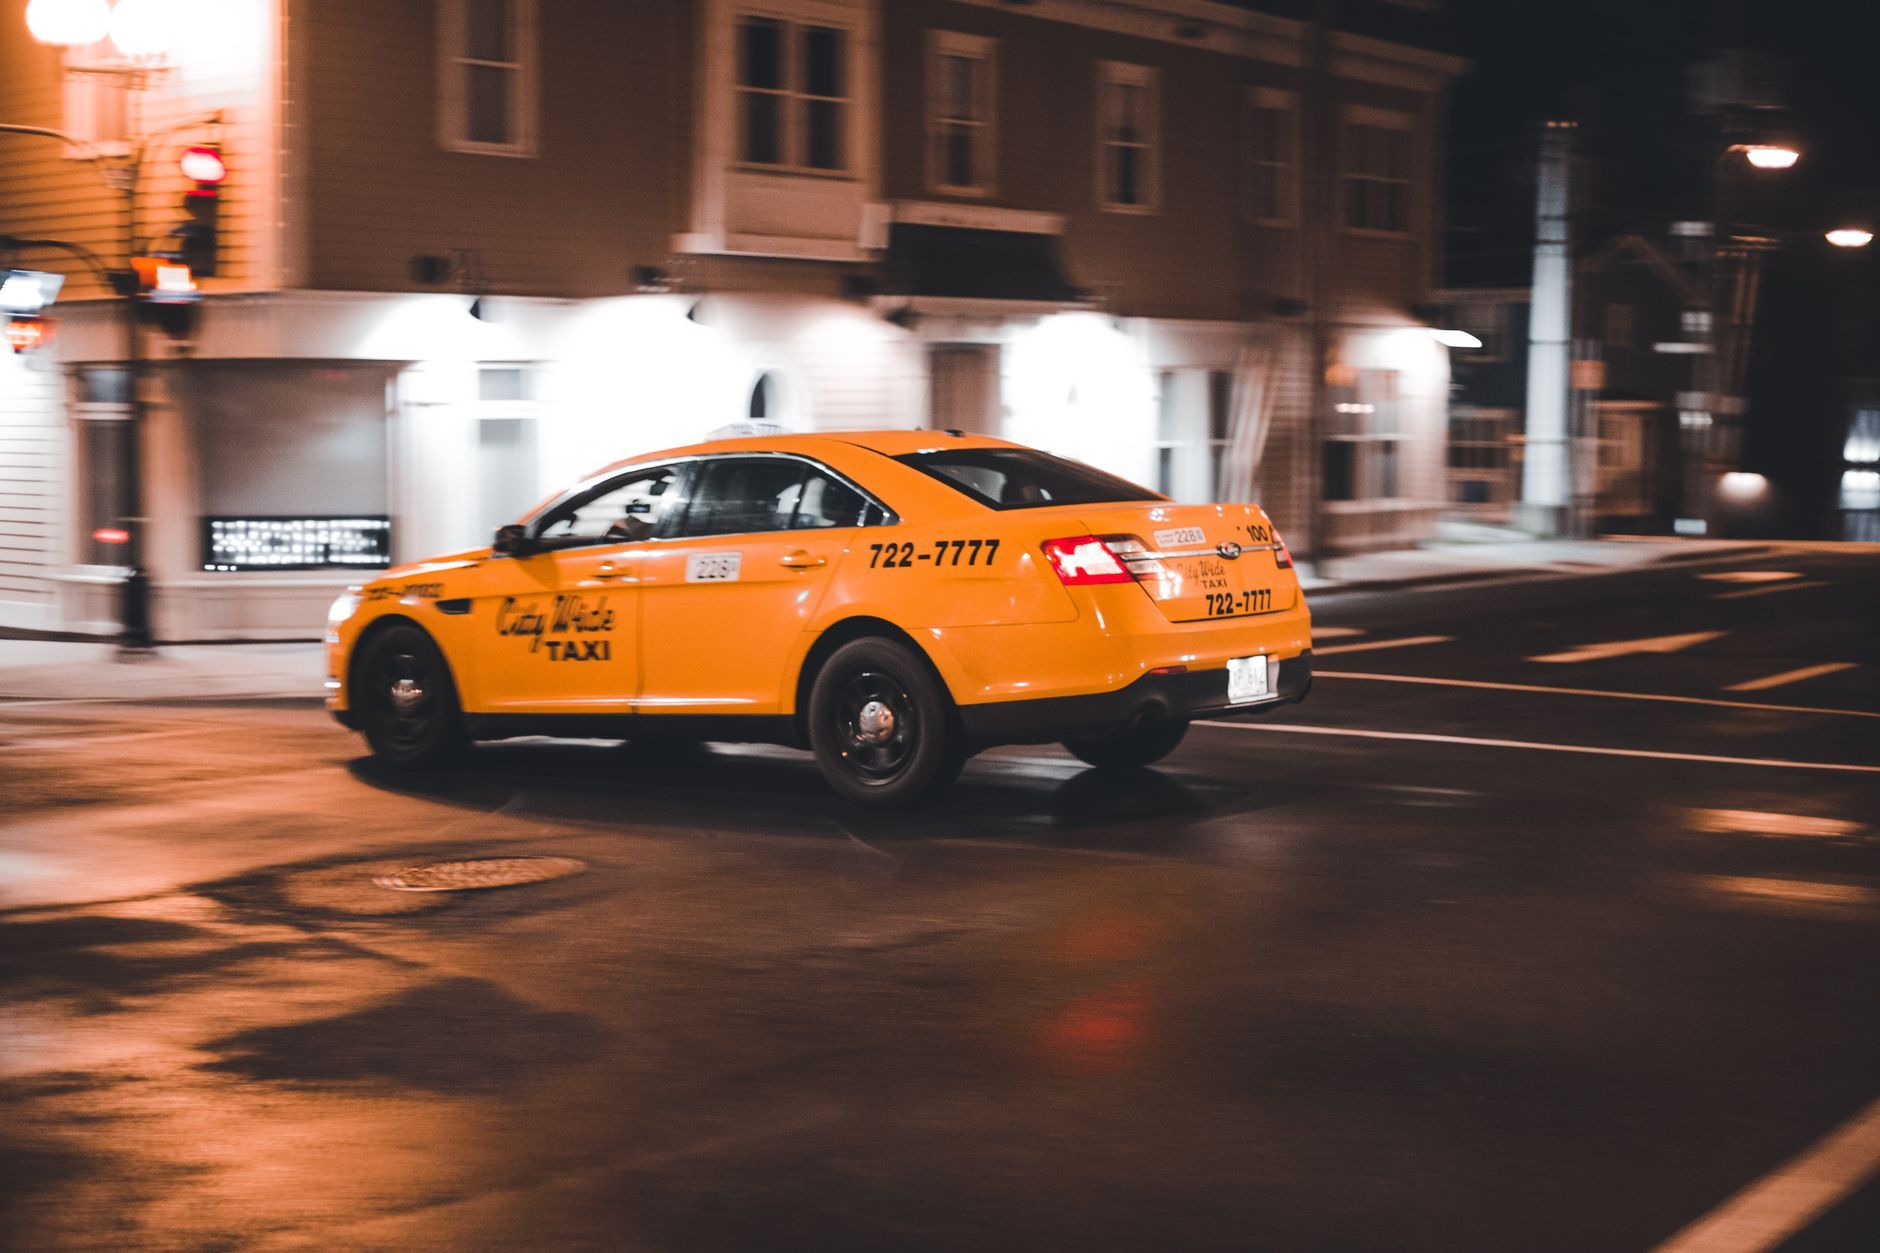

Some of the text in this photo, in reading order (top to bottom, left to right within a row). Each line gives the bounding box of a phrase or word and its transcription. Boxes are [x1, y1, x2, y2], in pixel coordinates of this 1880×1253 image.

[1174, 529, 1198, 543] 228
[1247, 525, 1269, 541] 100
[870, 539, 1000, 568] 722-7777
[1200, 560, 1226, 577] Wide
[1202, 579, 1228, 589] TAXI
[1205, 588, 1271, 616] 722-7777
[545, 640, 611, 661] TAXI
